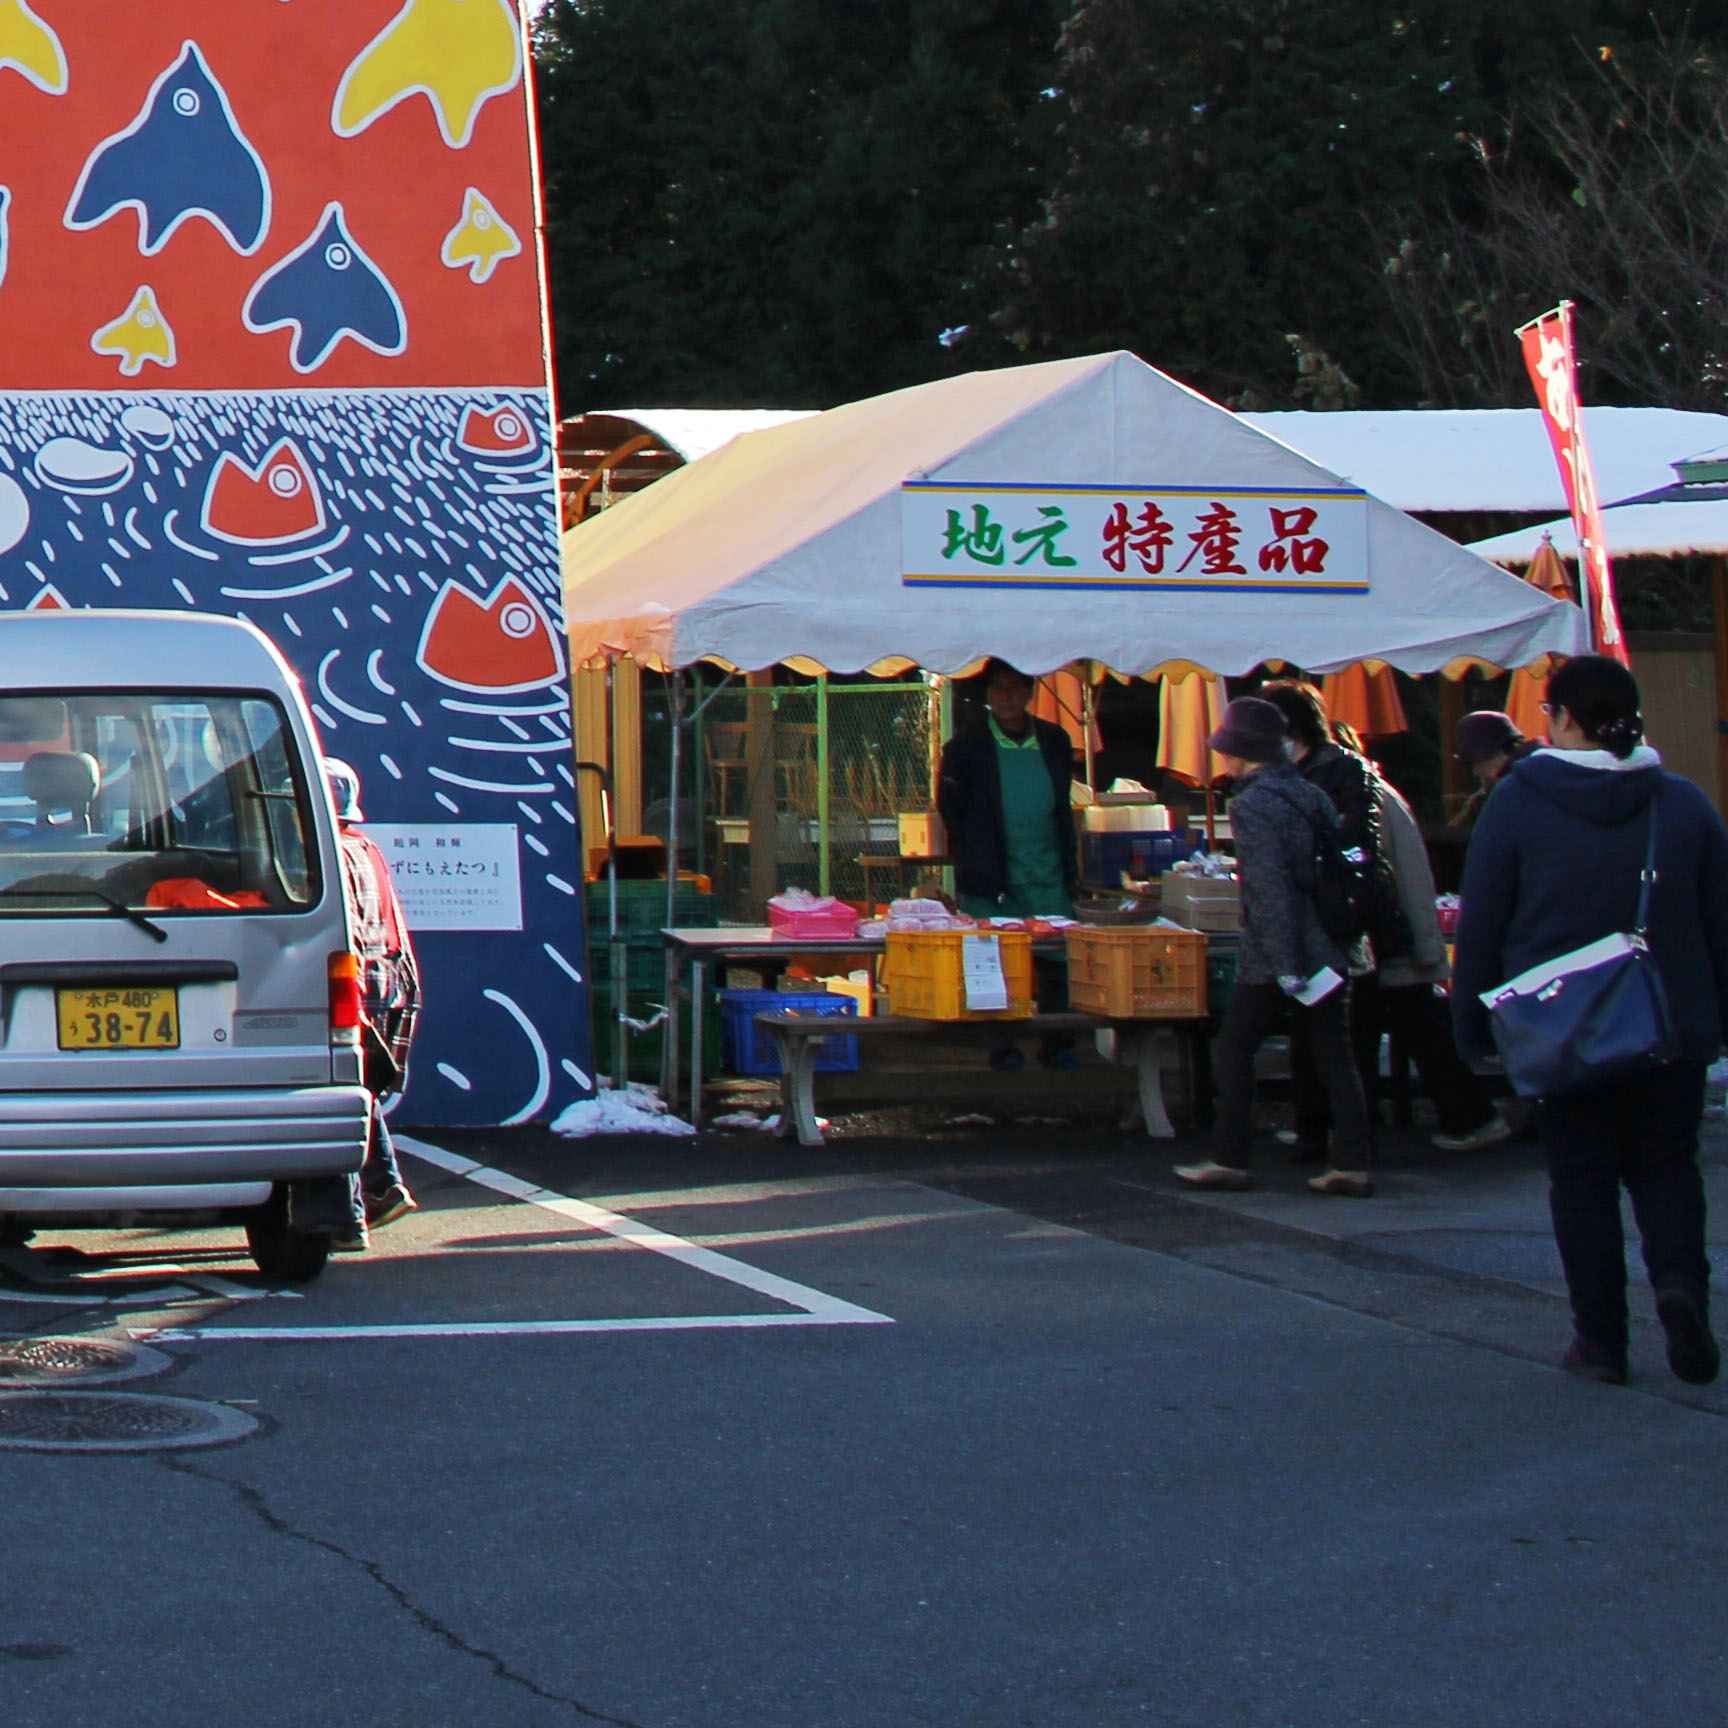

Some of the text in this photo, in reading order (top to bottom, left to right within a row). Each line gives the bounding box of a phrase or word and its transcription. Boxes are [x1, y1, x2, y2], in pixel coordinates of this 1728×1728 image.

[941, 501, 1330, 575] 地元 特産品
[84, 1011, 173, 1043] 38-74
